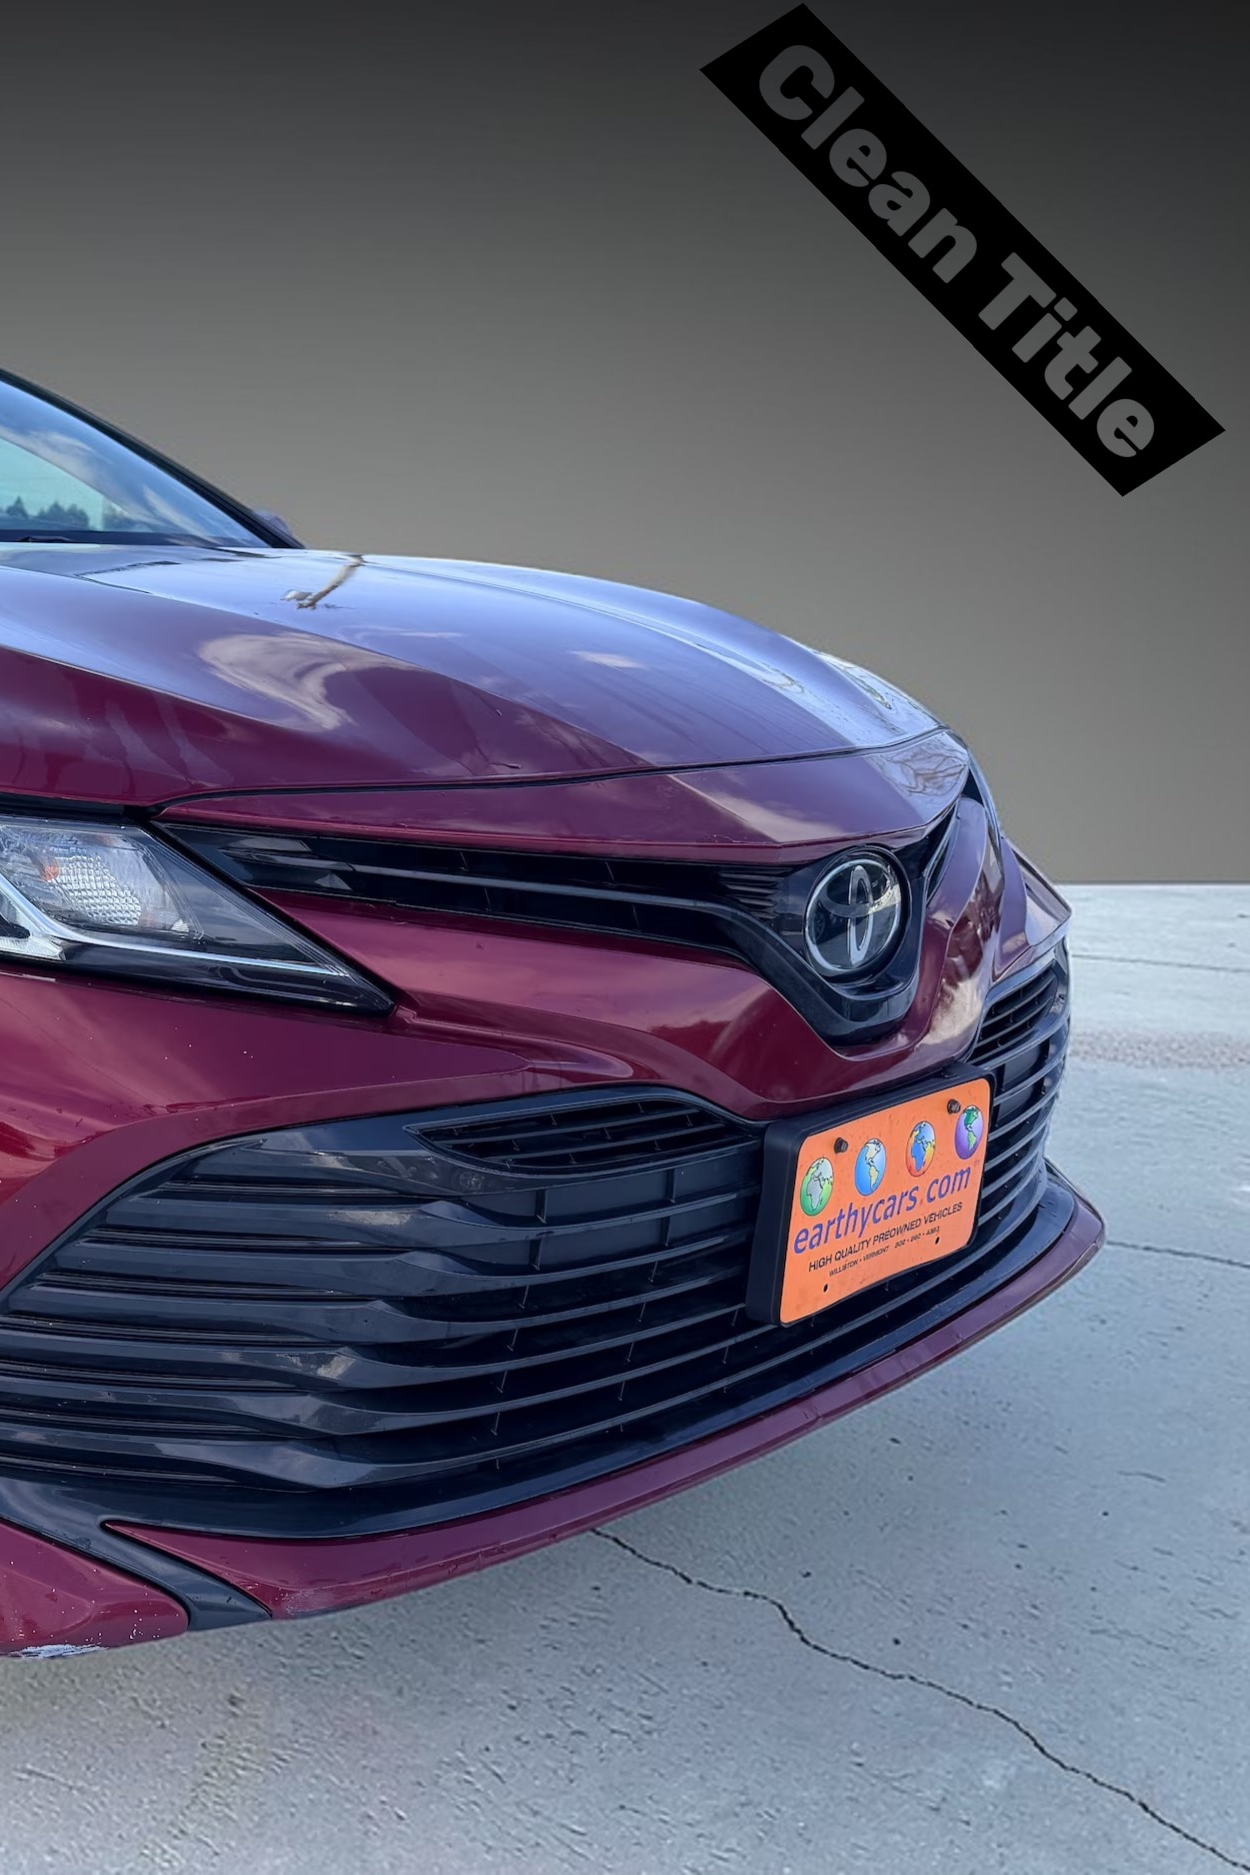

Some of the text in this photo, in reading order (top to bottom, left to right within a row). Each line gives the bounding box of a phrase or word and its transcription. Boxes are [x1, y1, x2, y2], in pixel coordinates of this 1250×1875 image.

[793, 1166, 971, 1254] earthycars.com
[808, 1201, 963, 1272] HIGH QUALITY PREOWNED VEHICLES
[828, 1260, 858, 1277] WILLISTON
[862, 1245, 890, 1261] VERMONT
